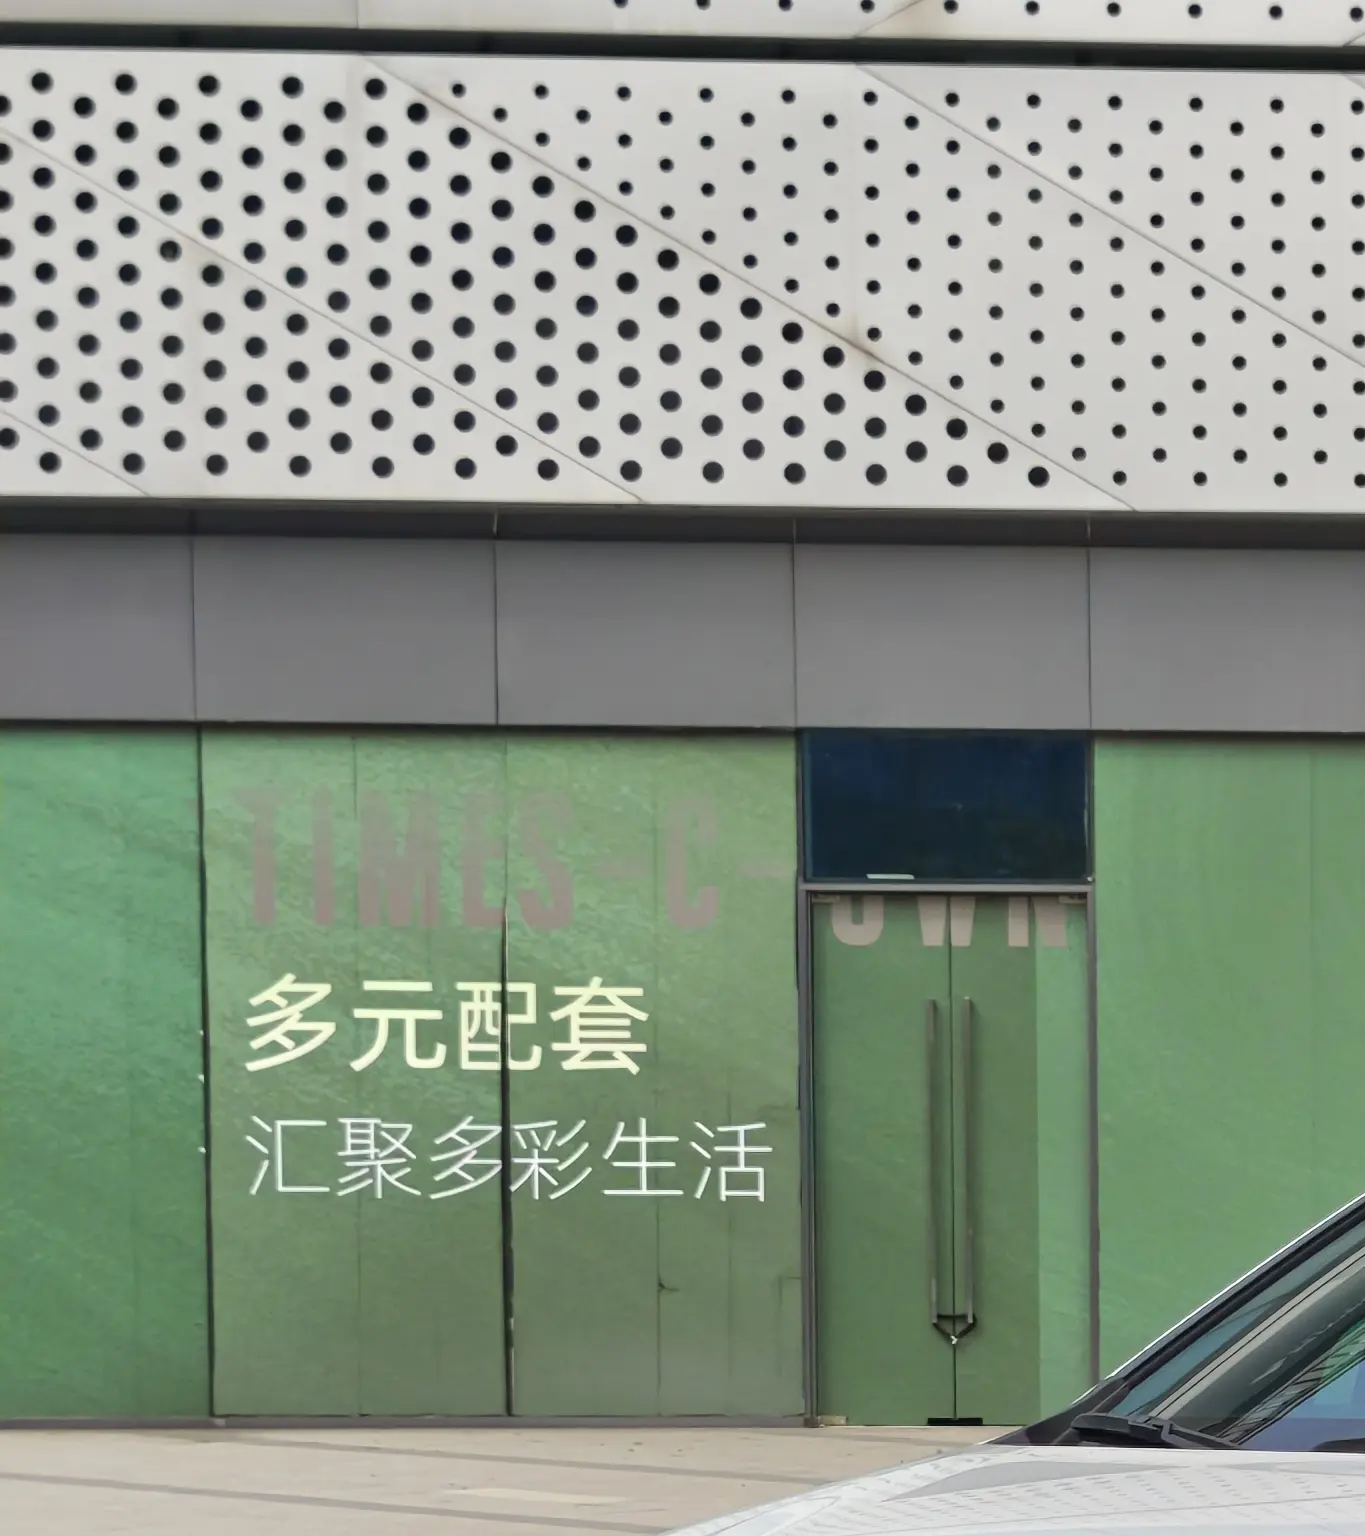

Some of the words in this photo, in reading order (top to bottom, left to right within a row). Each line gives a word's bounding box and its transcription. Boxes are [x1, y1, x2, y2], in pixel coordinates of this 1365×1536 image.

[244, 972, 650, 1076] 多元配套
[244, 1114, 773, 1203] 汇聚多彩生活
